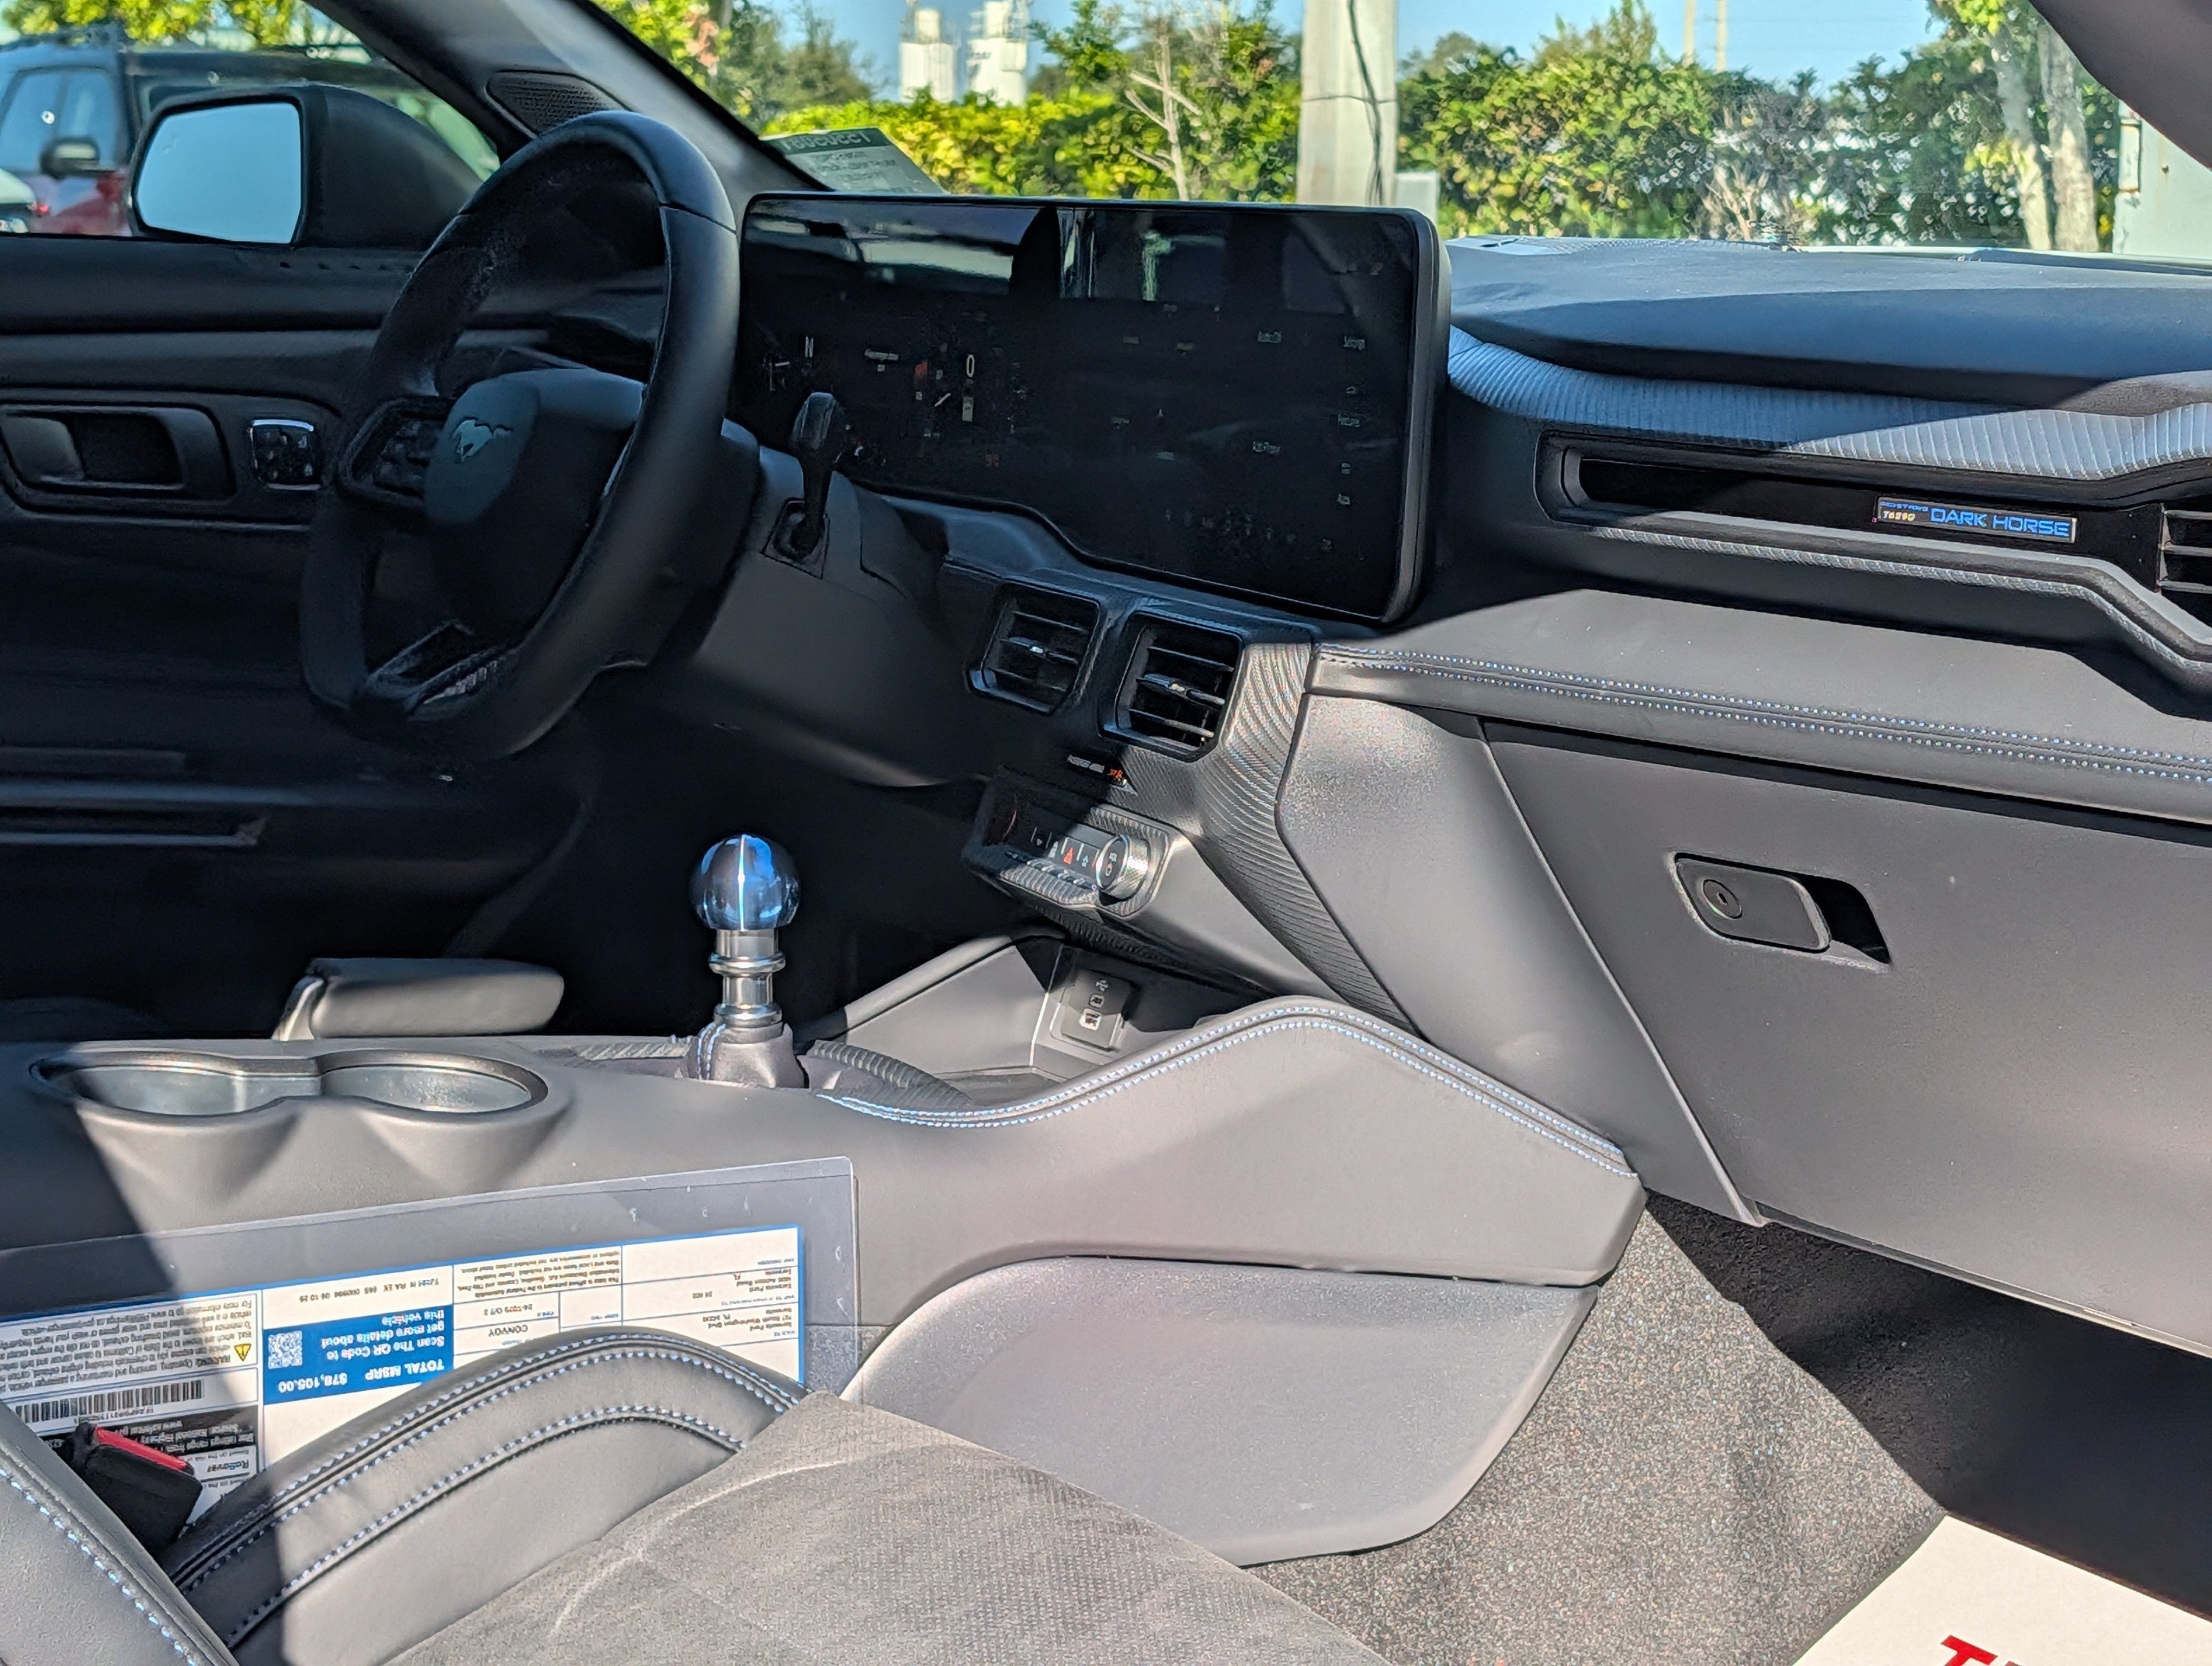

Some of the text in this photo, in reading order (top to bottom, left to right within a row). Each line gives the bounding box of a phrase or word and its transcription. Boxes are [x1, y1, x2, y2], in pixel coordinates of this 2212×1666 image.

[1930, 507, 2070, 537] DARK HORSE
[381, 1309, 445, 1326] this vehicle
[321, 1320, 445, 1349] get more details about
[488, 1325, 528, 1337] CONVOY
[326, 1336, 445, 1360] Scan The QR Code to
[365, 1366, 401, 1380] MSRP
[404, 1360, 445, 1374] TOTAL
